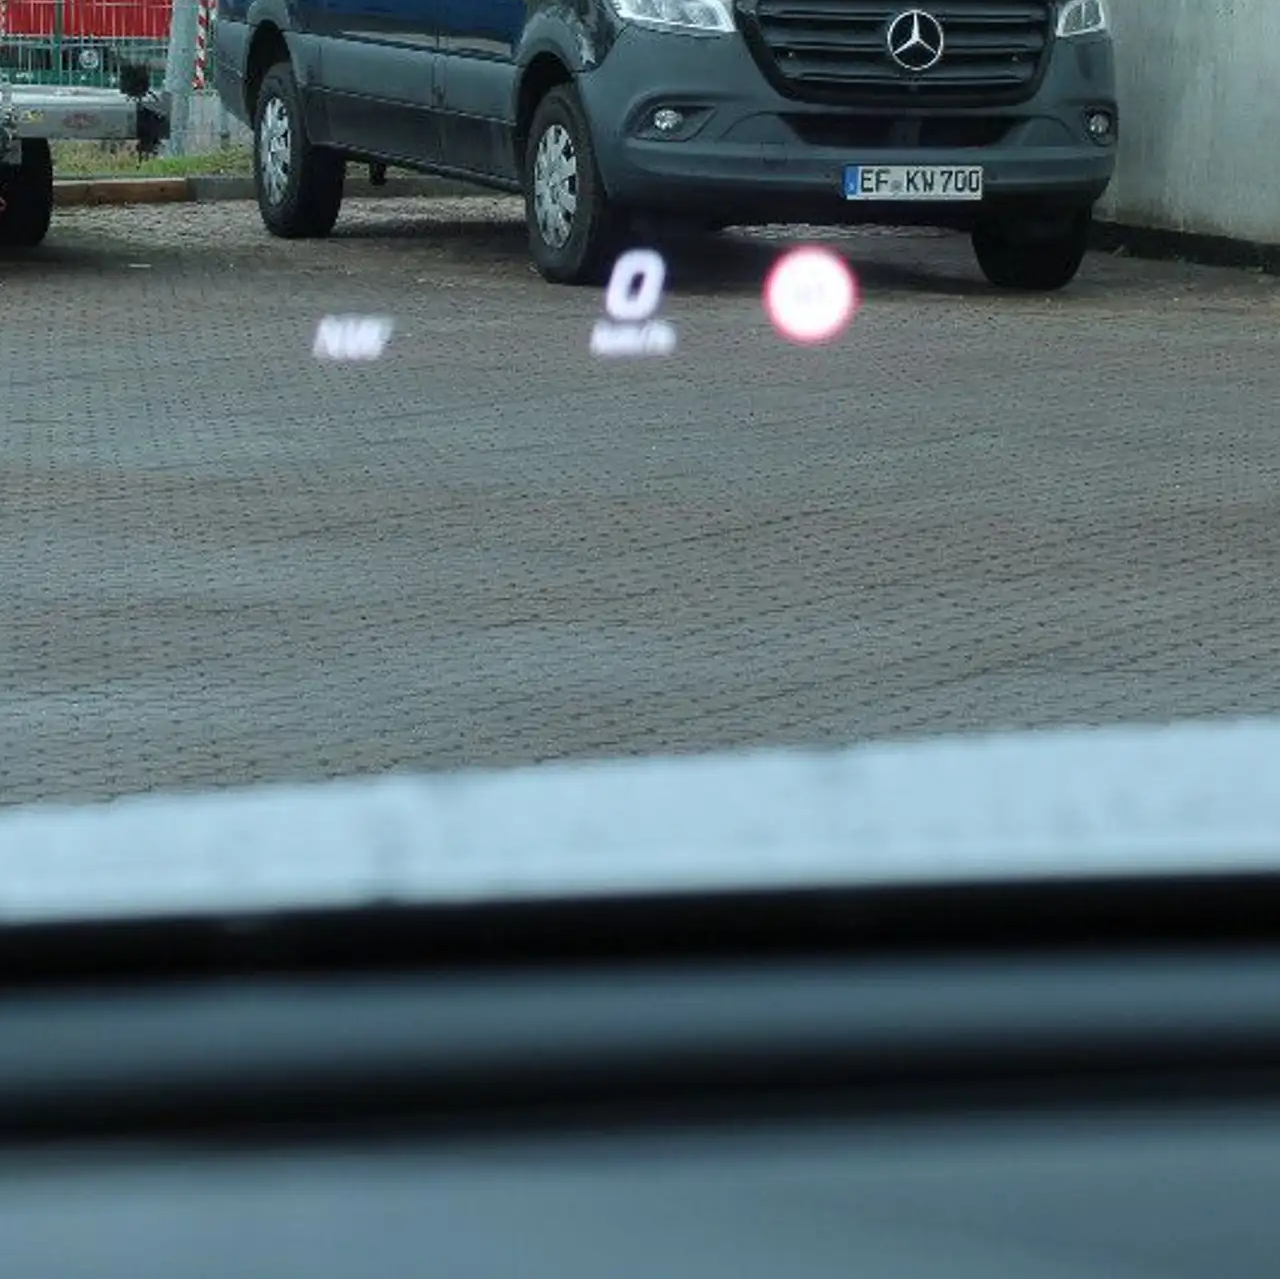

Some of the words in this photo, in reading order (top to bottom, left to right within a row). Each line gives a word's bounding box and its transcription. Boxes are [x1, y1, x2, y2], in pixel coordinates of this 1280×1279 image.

[860, 169, 889, 193] EF
[906, 170, 934, 193] KW
[940, 170, 980, 192] 700
